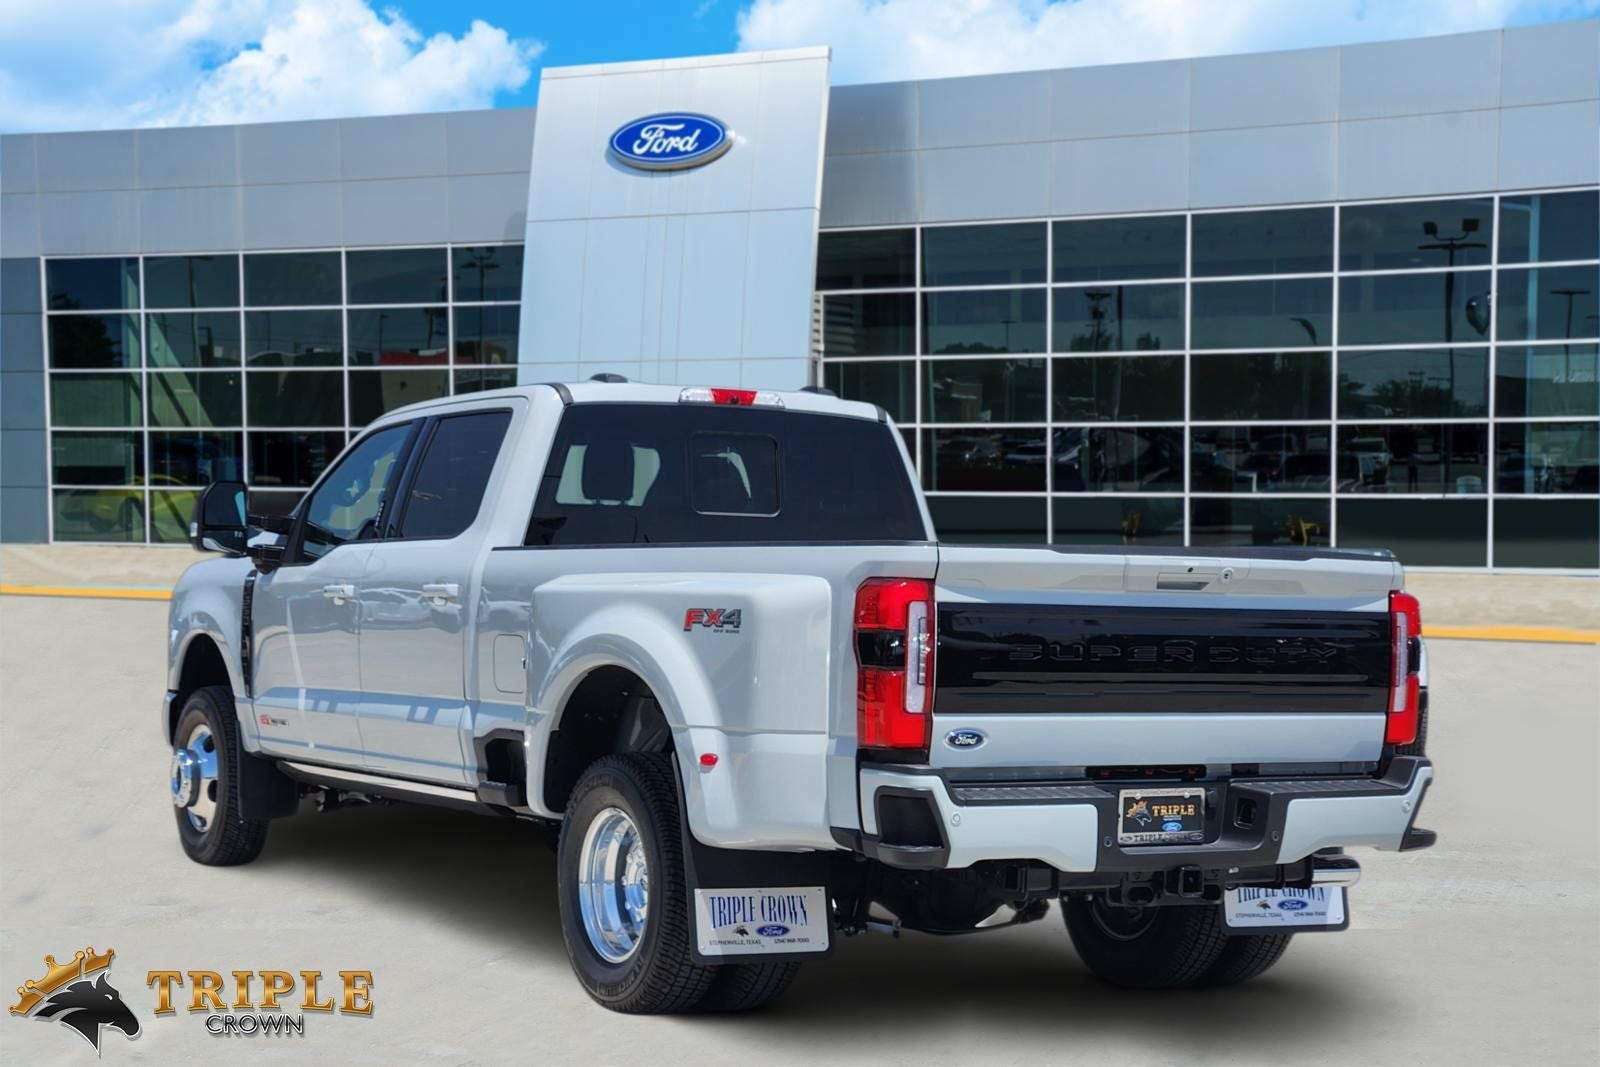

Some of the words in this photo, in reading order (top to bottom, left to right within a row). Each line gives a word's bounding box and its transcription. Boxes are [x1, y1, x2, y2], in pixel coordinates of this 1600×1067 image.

[633, 123, 702, 155] Ford
[683, 608, 741, 631] FX4
[1008, 643, 1196, 663] SUPER
[1209, 645, 1338, 664] DUTY
[1151, 804, 1196, 816] TRIPLE
[709, 896, 757, 929] TRIPLE
[760, 895, 808, 928] CROWN
